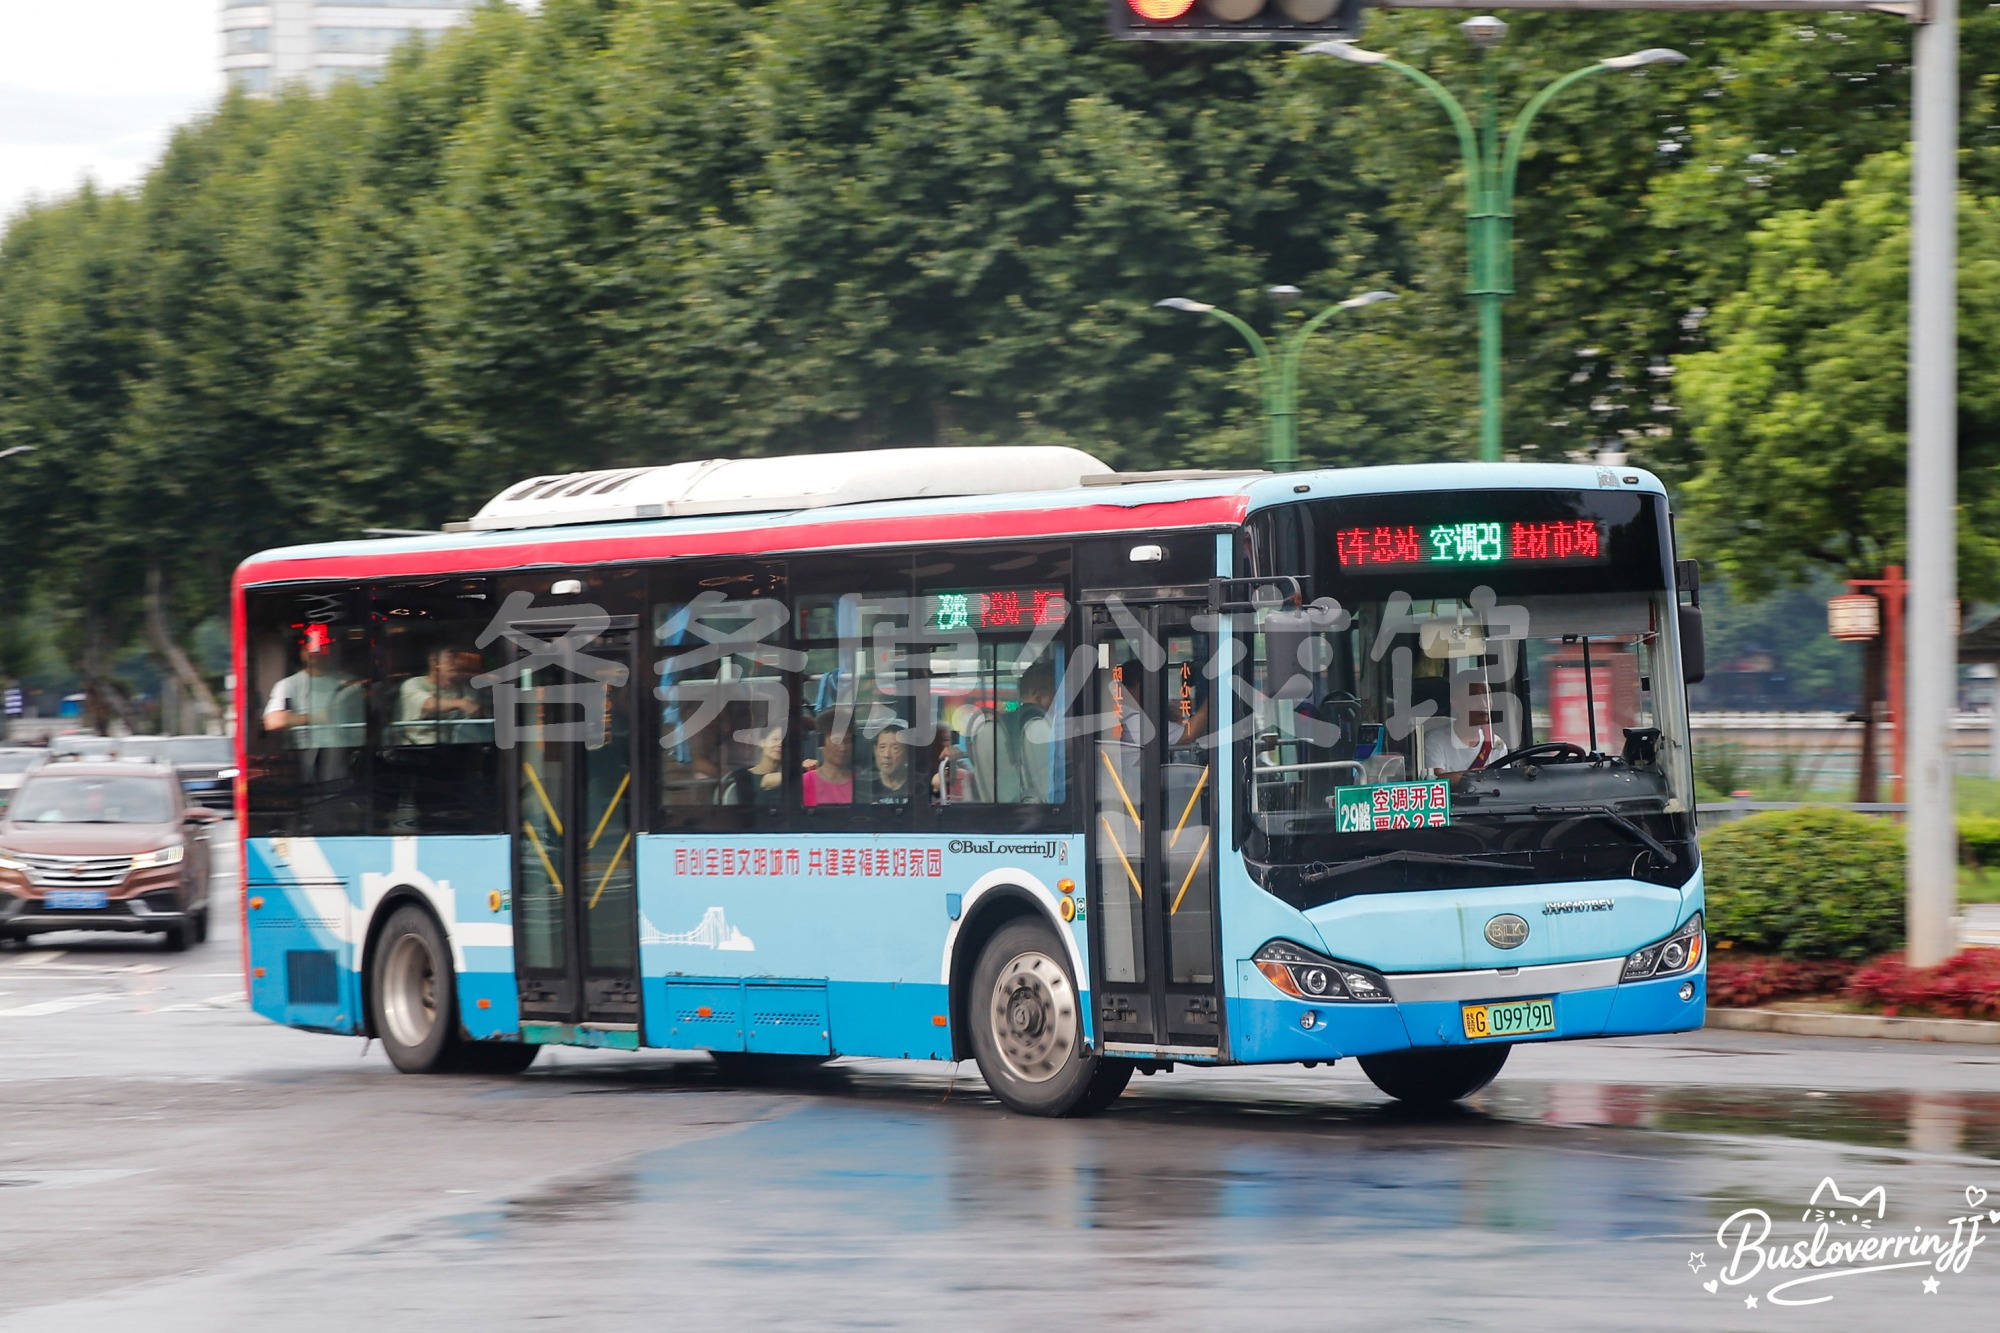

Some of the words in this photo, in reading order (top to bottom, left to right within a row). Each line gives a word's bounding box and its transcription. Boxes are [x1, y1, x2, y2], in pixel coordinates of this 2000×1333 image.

[1430, 522, 1501, 561] 空调29
[1373, 784, 1446, 813] 空调开启
[1340, 801, 1370, 832] 29路
[1373, 812, 1446, 831] 票价2元
[674, 848, 801, 876] 同创全国文明城市
[808, 848, 942, 877] 共建幸福美好家园
[1542, 898, 1615, 916] JXK6107BEV
